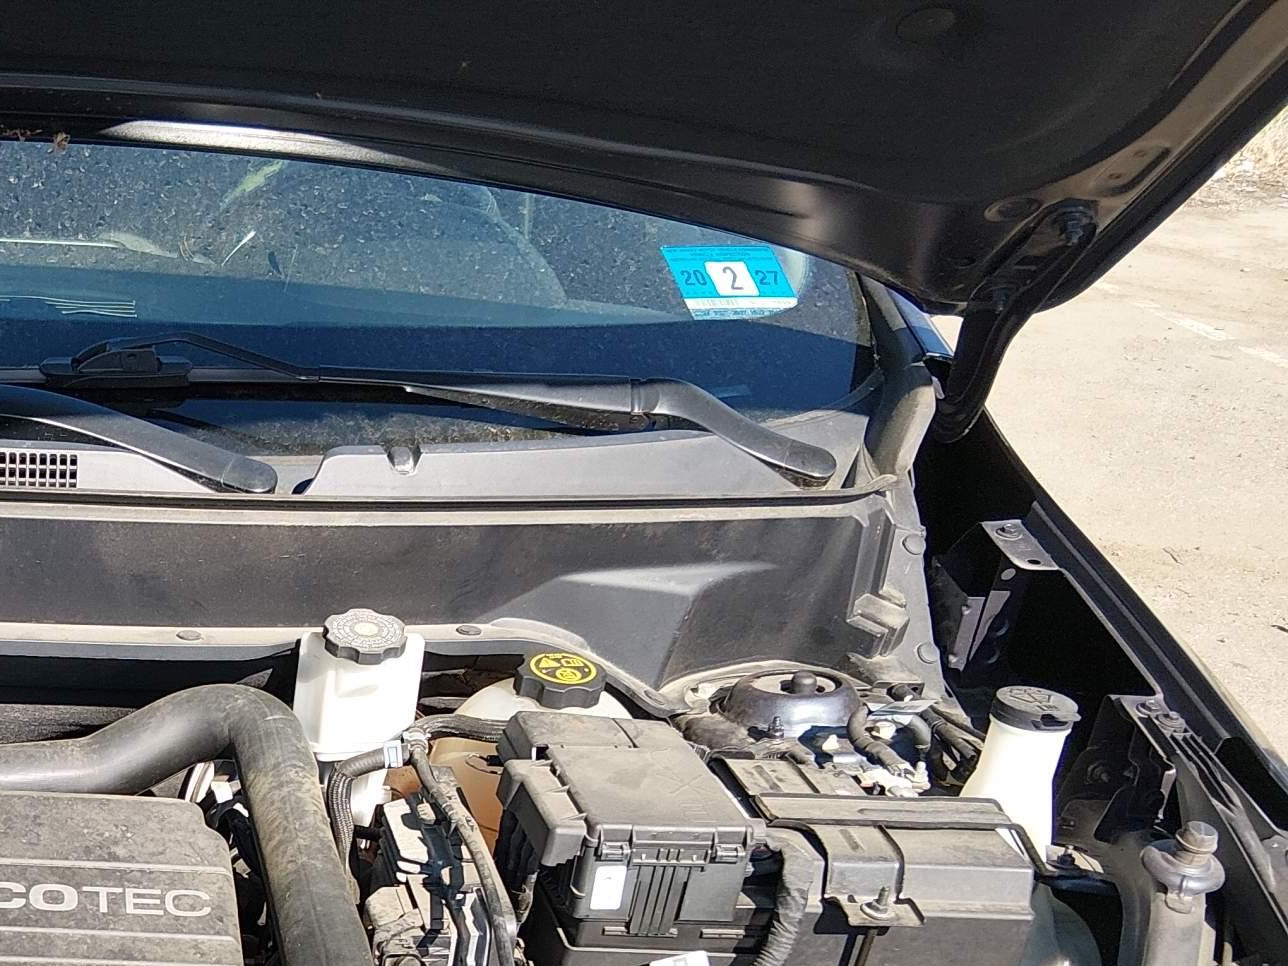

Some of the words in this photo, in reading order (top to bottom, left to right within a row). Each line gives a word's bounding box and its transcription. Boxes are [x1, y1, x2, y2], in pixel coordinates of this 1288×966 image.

[680, 269, 708, 286] 20
[722, 266, 745, 290] 2
[755, 270, 778, 286] 27
